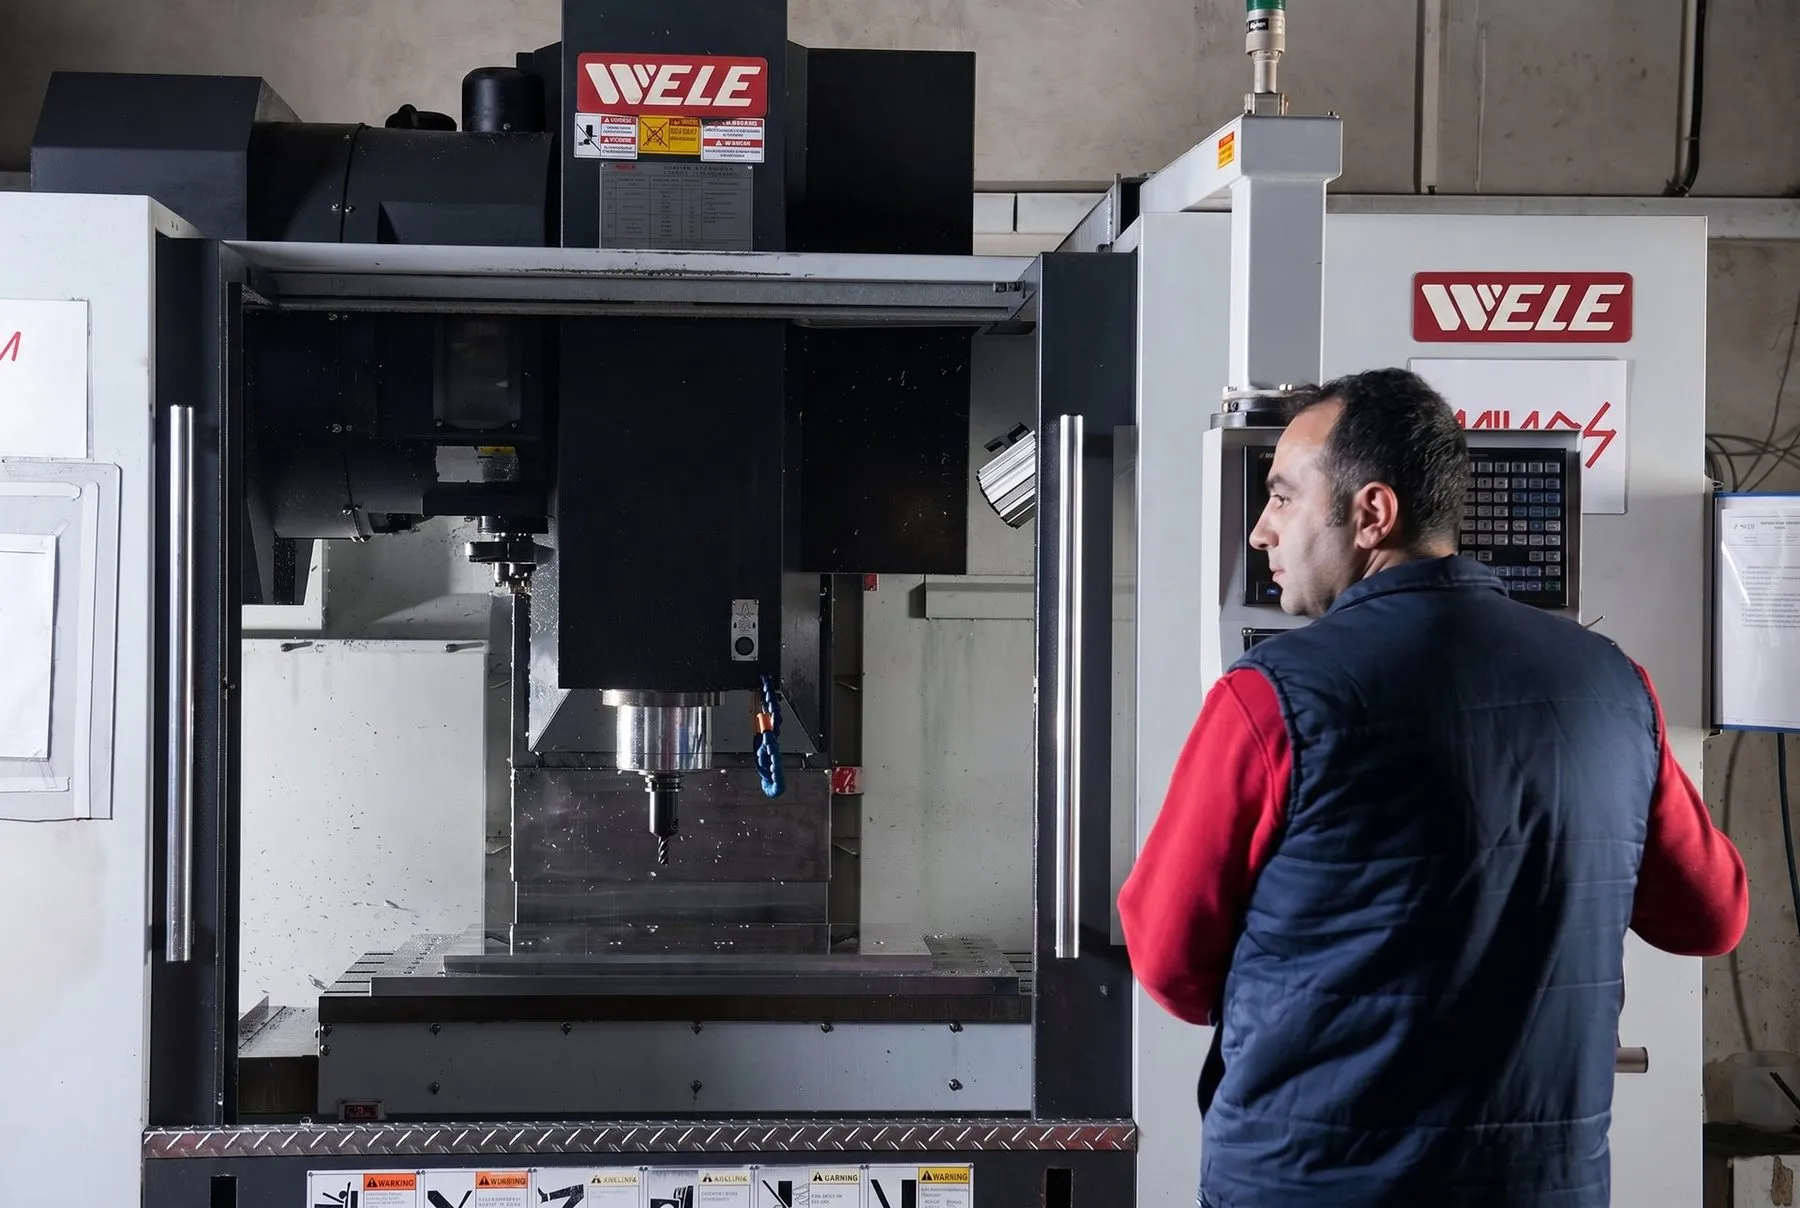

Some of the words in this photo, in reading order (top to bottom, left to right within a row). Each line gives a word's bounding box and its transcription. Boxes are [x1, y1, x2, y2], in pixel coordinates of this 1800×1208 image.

[585, 63, 761, 107] WELE
[1421, 284, 1625, 332] WELE
[932, 1173, 968, 1181] WARNING
